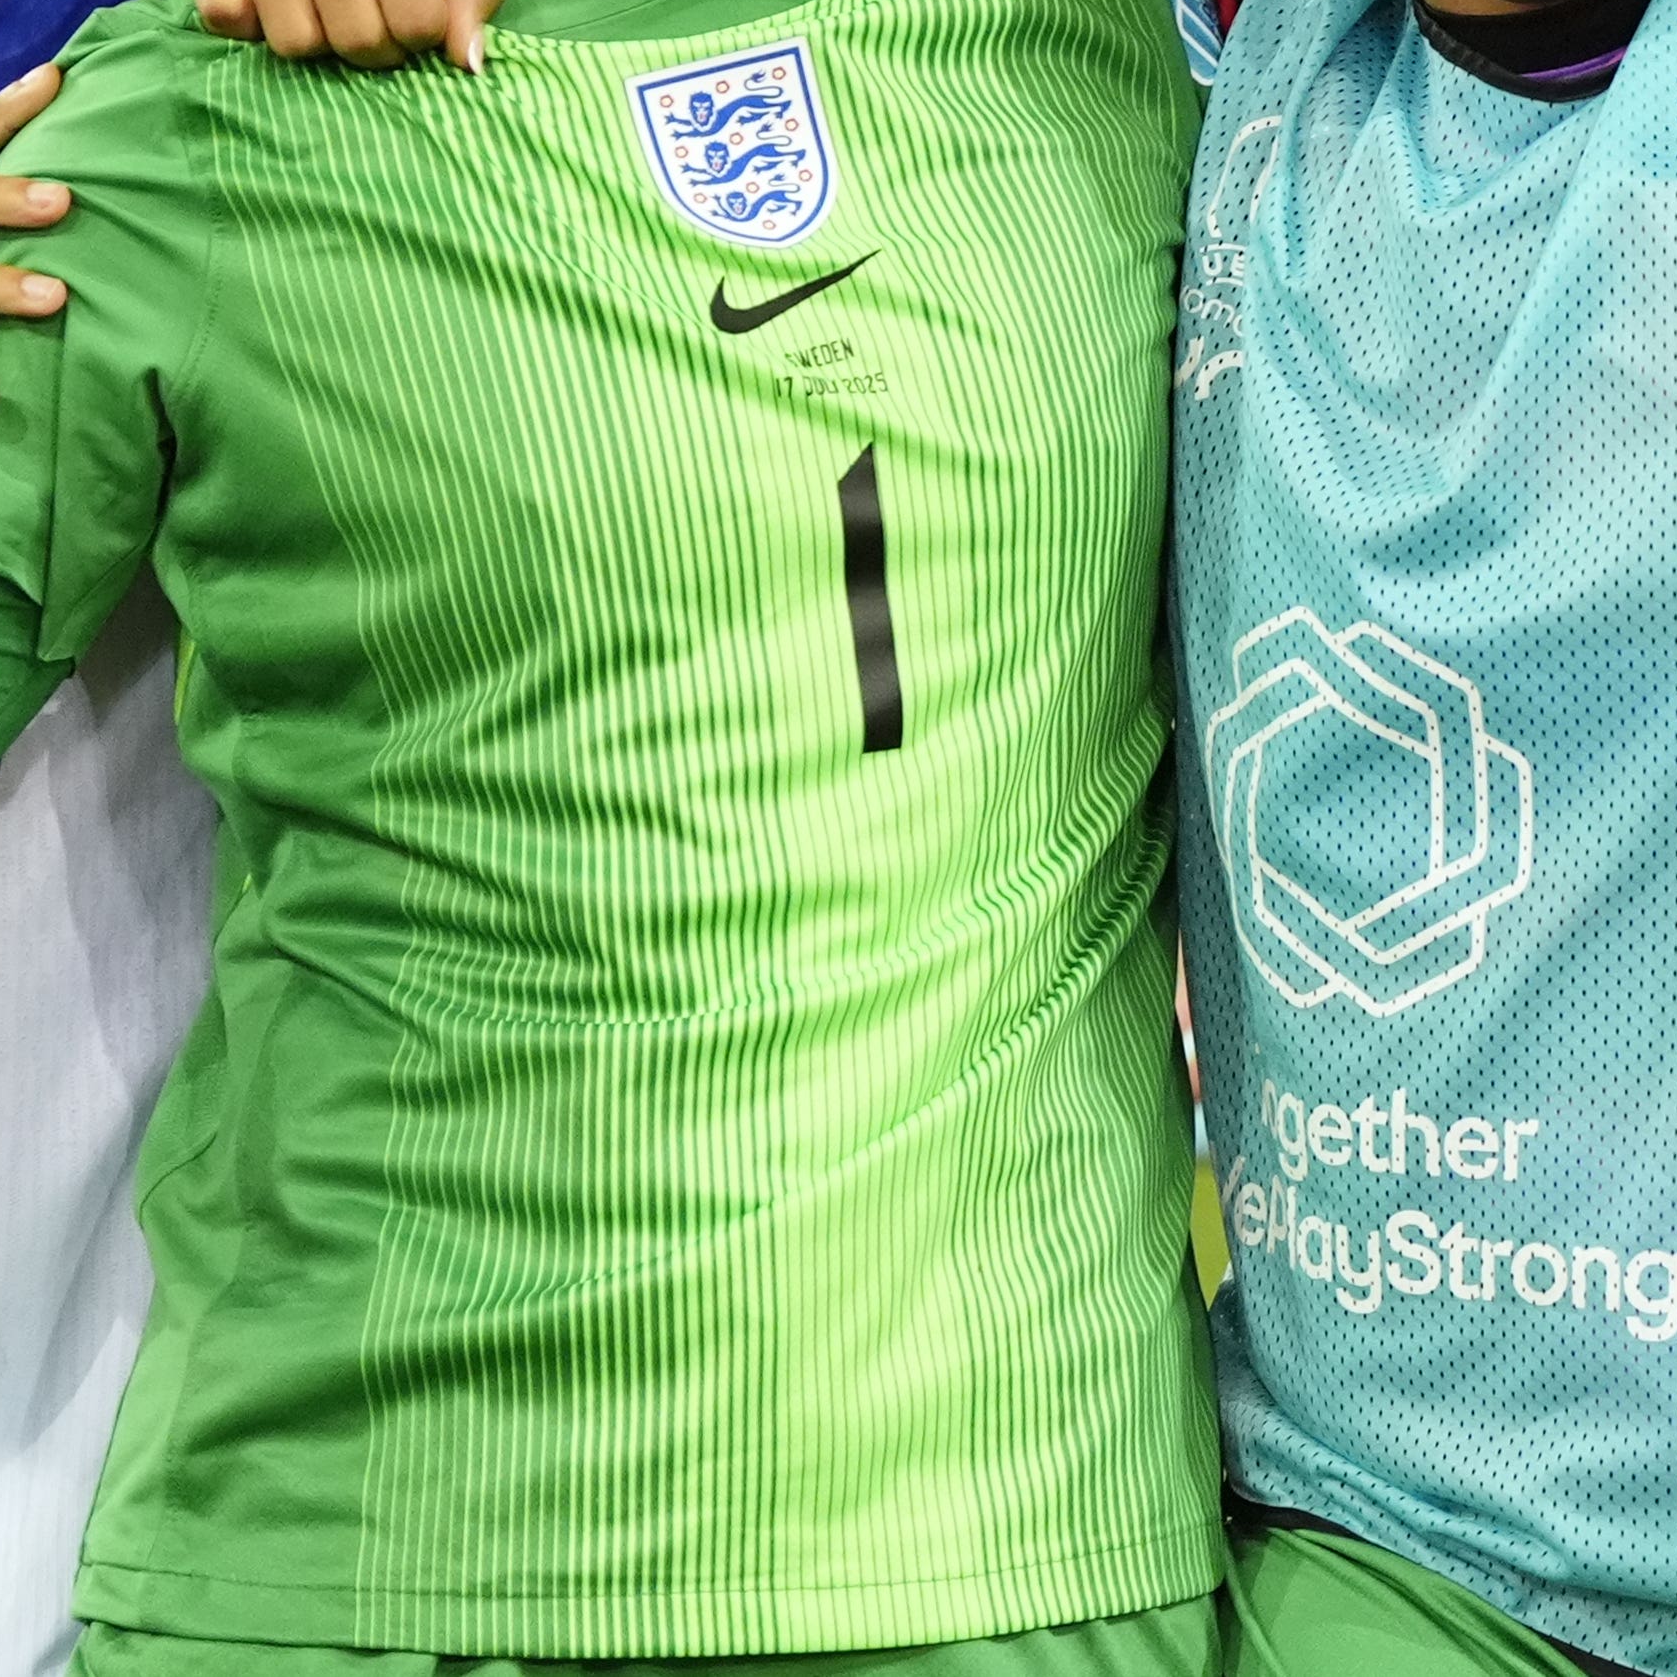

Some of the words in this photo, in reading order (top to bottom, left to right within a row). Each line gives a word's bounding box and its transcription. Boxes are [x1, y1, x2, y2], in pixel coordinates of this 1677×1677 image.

[785, 338, 854, 367] SWEDEN
[776, 376, 793, 398] 17
[841, 371, 888, 395] 2025
[837, 441, 904, 754] 1
